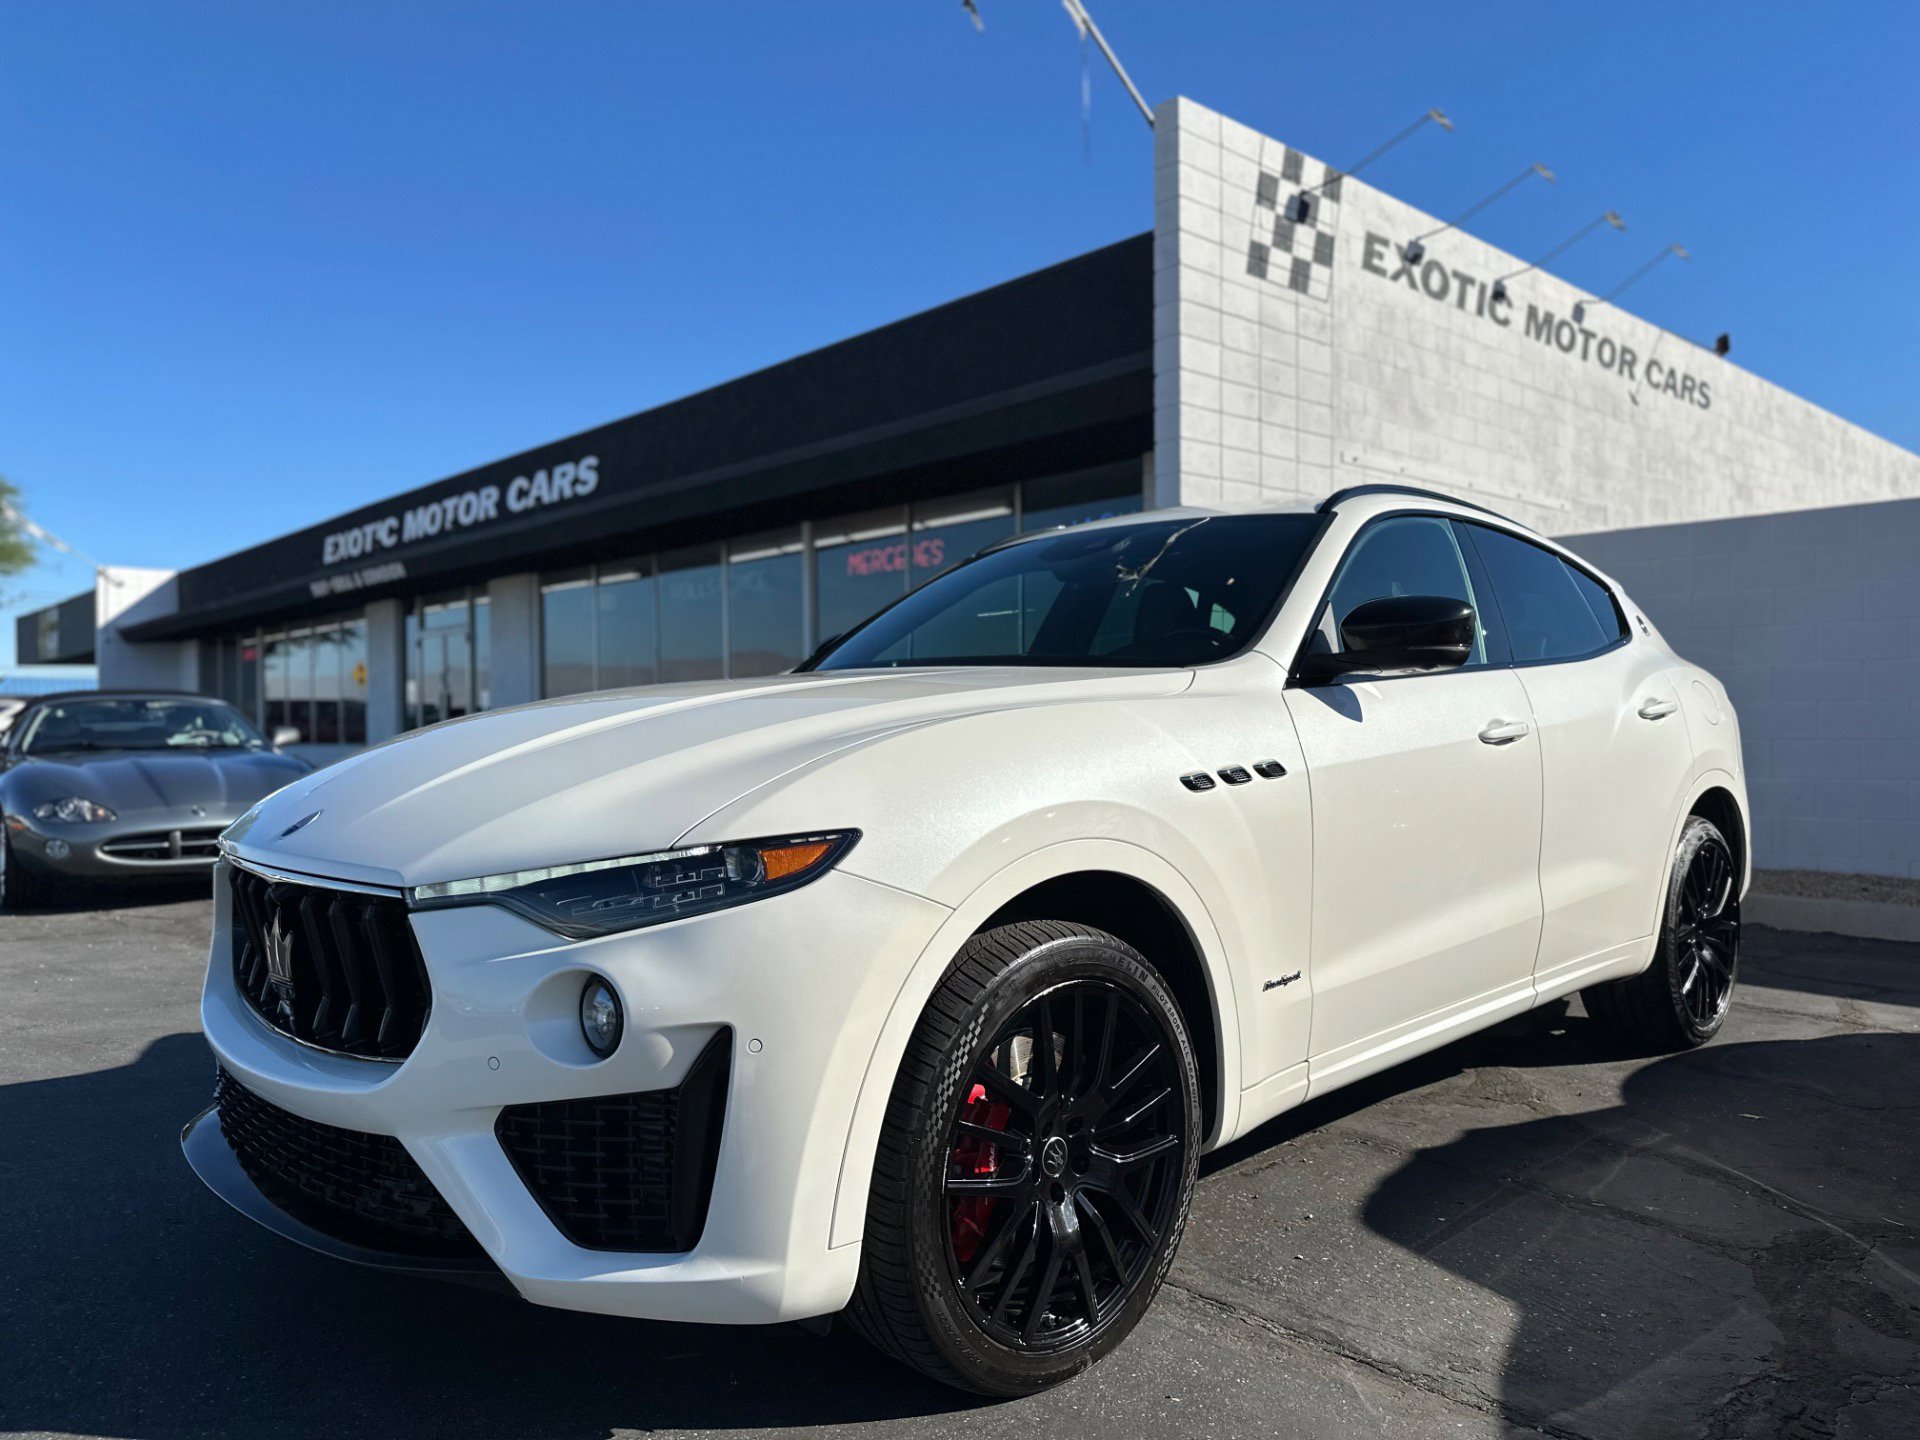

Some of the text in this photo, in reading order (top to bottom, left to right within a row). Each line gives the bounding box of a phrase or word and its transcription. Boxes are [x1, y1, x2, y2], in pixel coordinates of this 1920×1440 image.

[1361, 231, 1711, 410] EXOTIC MOTOR CARS
[402, 485, 500, 542] MOTOR
[506, 455, 600, 512] CARS
[1077, 947, 1148, 983] CHELIN
[1151, 984, 1169, 1006] PILOT
[1167, 1005, 1183, 1036] SPORT
[1181, 1040, 1191, 1057] ALL
